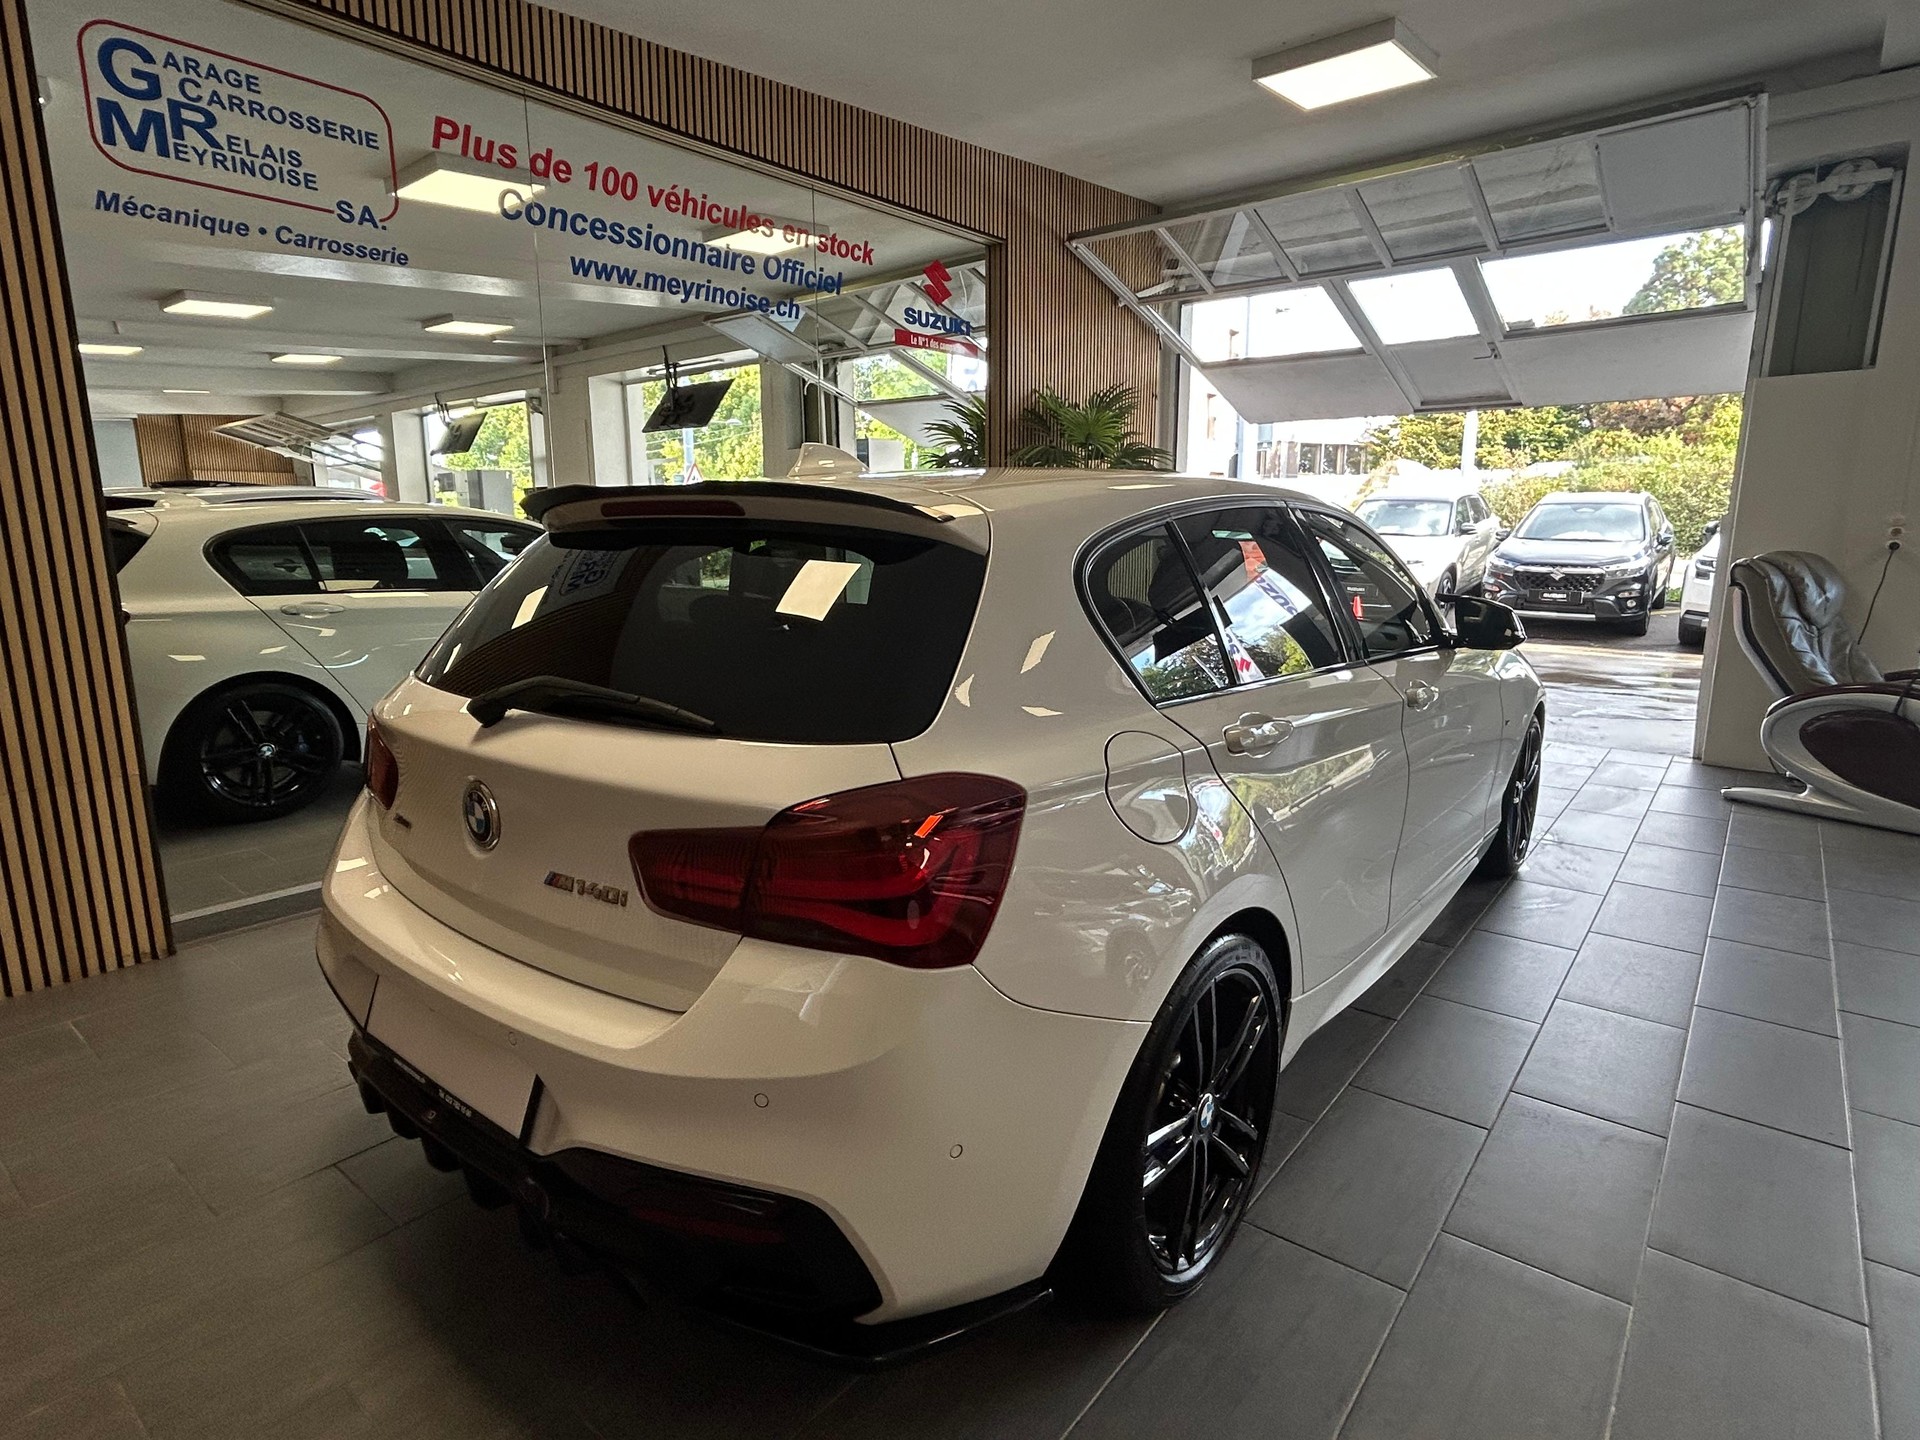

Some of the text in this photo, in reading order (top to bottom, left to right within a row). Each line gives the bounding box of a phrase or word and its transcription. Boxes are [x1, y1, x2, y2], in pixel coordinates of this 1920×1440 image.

[97, 37, 262, 102] GARAGE
[96, 97, 320, 192] MEYRINOISE
[166, 98, 304, 169] RELAIS
[178, 77, 381, 151] CARROSSERIE
[432, 115, 875, 266] Plus de 100 véhicules en stock
[94, 189, 410, 266] Mécanique Carrosserie
[498, 188, 843, 296] Concessionnaire Officiel
[570, 255, 801, 320] www.meyrinoise.ch
[903, 306, 971, 337] SUZUKI
[910, 334, 918, 346] Le
